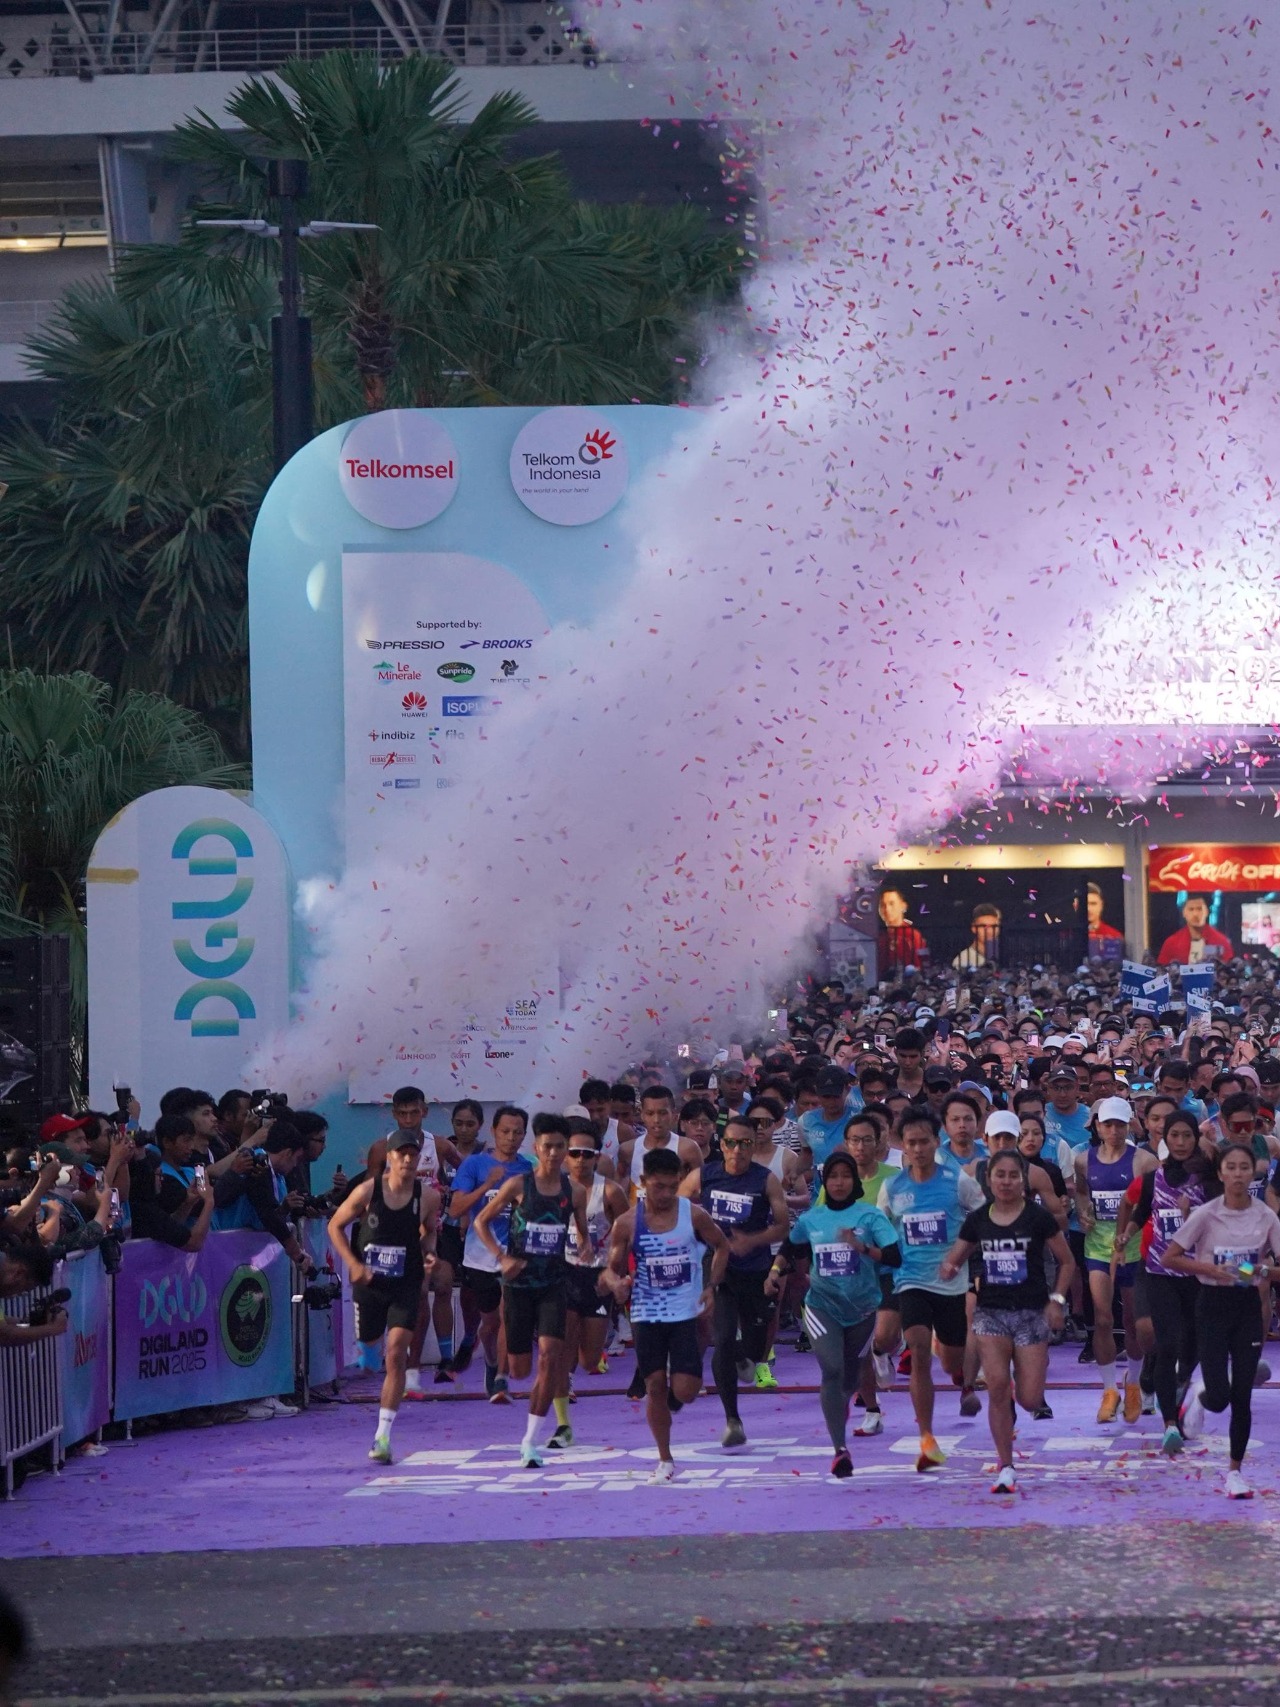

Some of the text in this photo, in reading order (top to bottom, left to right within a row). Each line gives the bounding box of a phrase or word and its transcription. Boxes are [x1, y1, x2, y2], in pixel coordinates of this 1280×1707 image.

[522, 453, 575, 467] Telkom
[346, 458, 454, 479] Telkomsel
[529, 467, 601, 480] Indonesia
[416, 620, 482, 630] Supported by:
[383, 640, 445, 650] PRESSIO
[482, 639, 533, 649] BROOKS
[397, 662, 410, 672] Le
[439, 667, 473, 676] Sunpride
[378, 671, 421, 681] Minerale
[381, 731, 416, 740] indibiz
[1121, 984, 1140, 996] SUB
[515, 1000, 537, 1009] SEA
[726, 1201, 742, 1214] 7155
[139, 1328, 208, 1357] DIGILAND
[139, 1351, 207, 1380] RUN 2025
